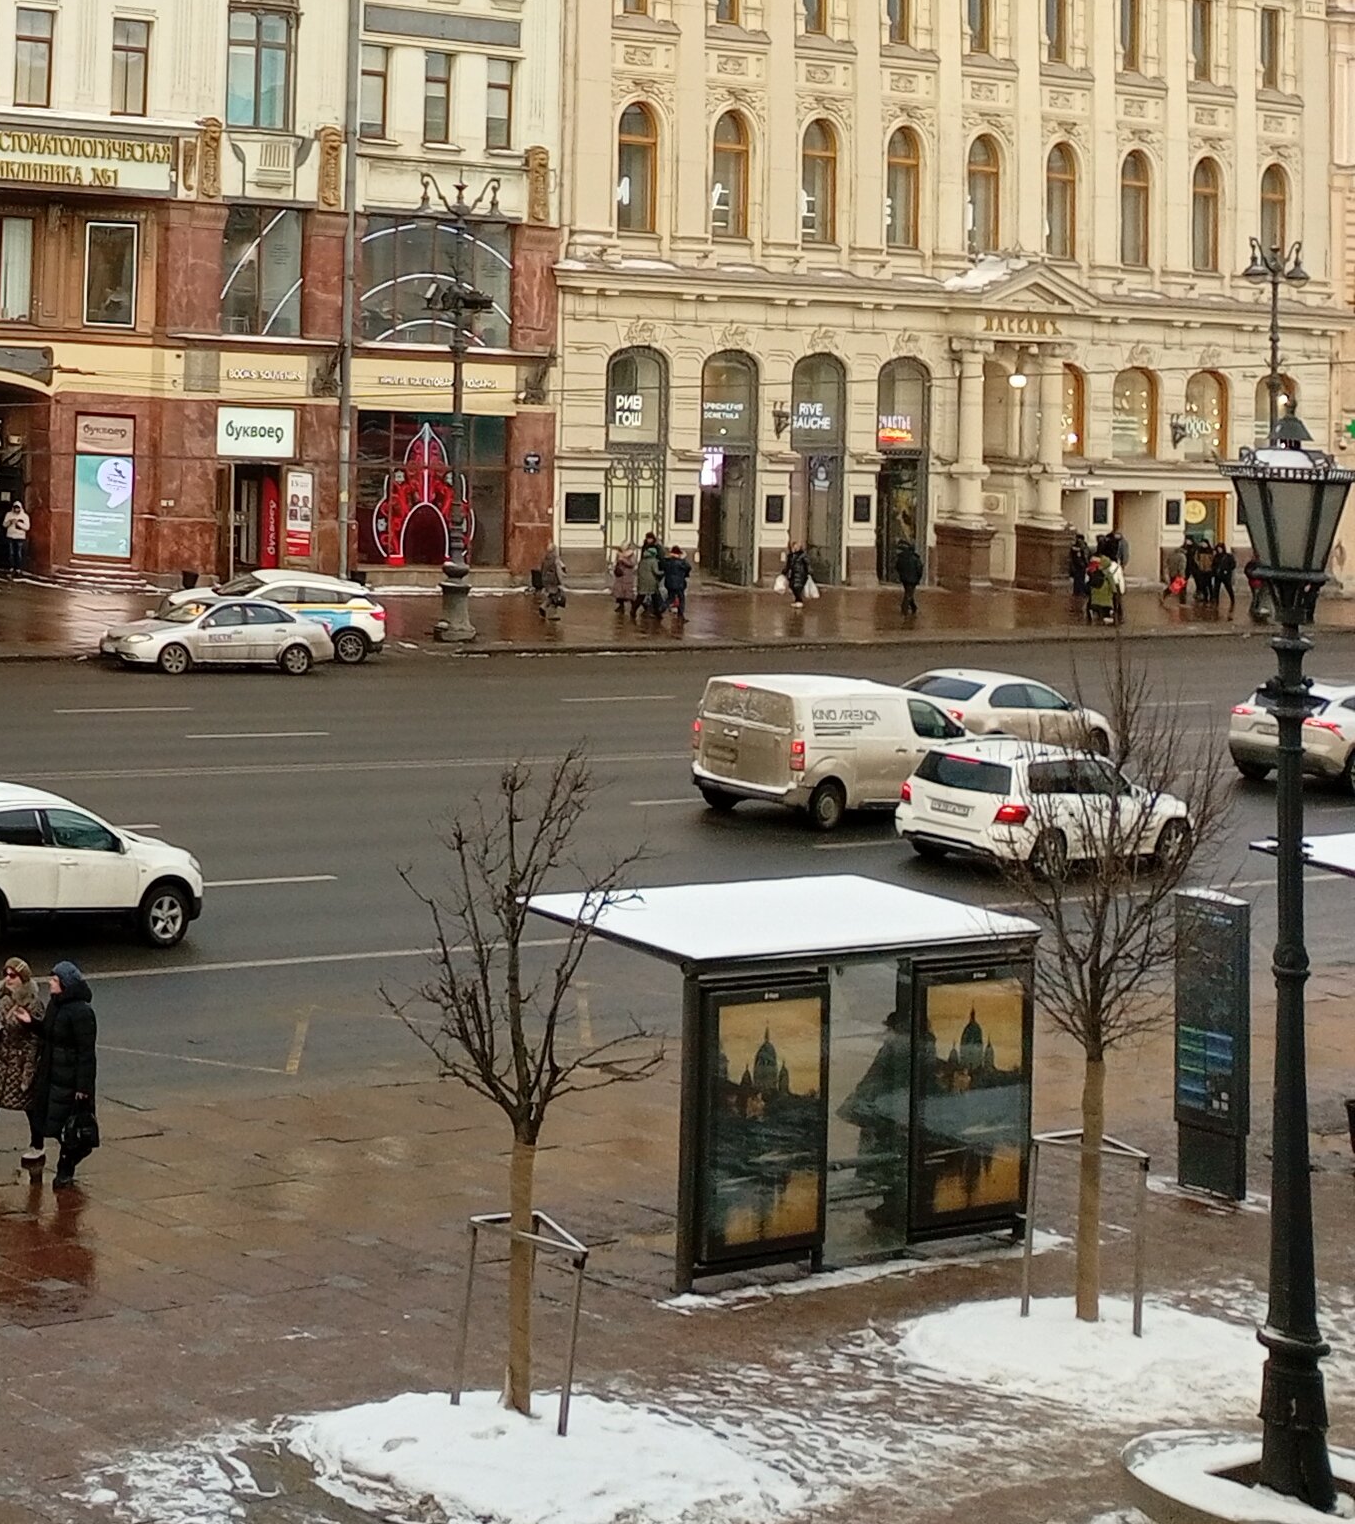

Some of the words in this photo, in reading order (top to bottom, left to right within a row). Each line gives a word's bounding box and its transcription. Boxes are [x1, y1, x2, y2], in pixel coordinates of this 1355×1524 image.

[615, 394, 642, 410] РИВ
[703, 402, 744, 411] АРФЮМЕРИЯ
[703, 411, 740, 420] ОСМЕТИКА
[799, 403, 823, 416] RIVE
[615, 412, 641, 426] ГОШ
[225, 420, 284, 443] буквоед
